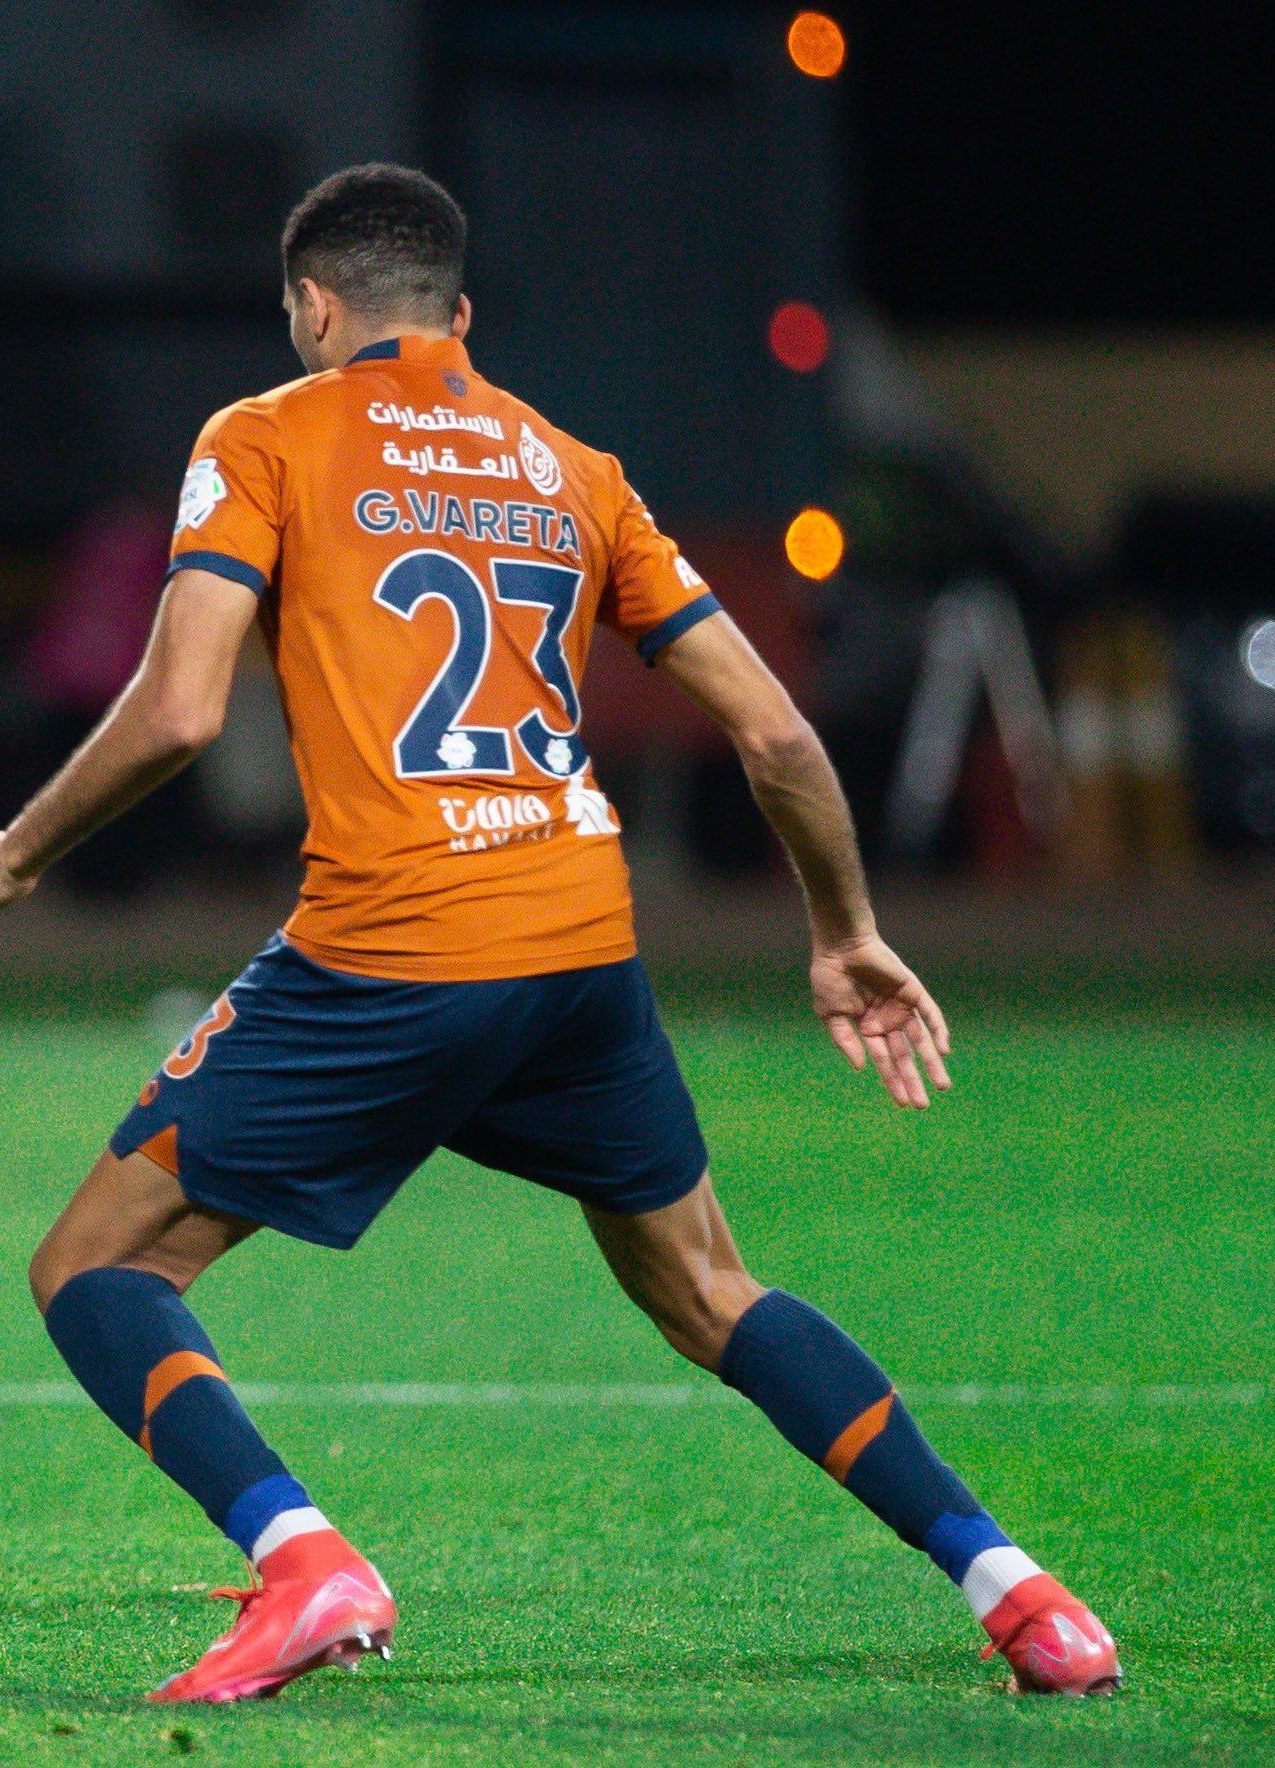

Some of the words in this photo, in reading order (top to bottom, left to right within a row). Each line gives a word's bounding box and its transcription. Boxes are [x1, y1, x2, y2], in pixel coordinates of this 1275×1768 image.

[366, 401, 505, 441] للاستثمارات
[382, 441, 519, 480] العقارية
[353, 488, 582, 560] G.VARETA
[373, 548, 590, 780] 23
